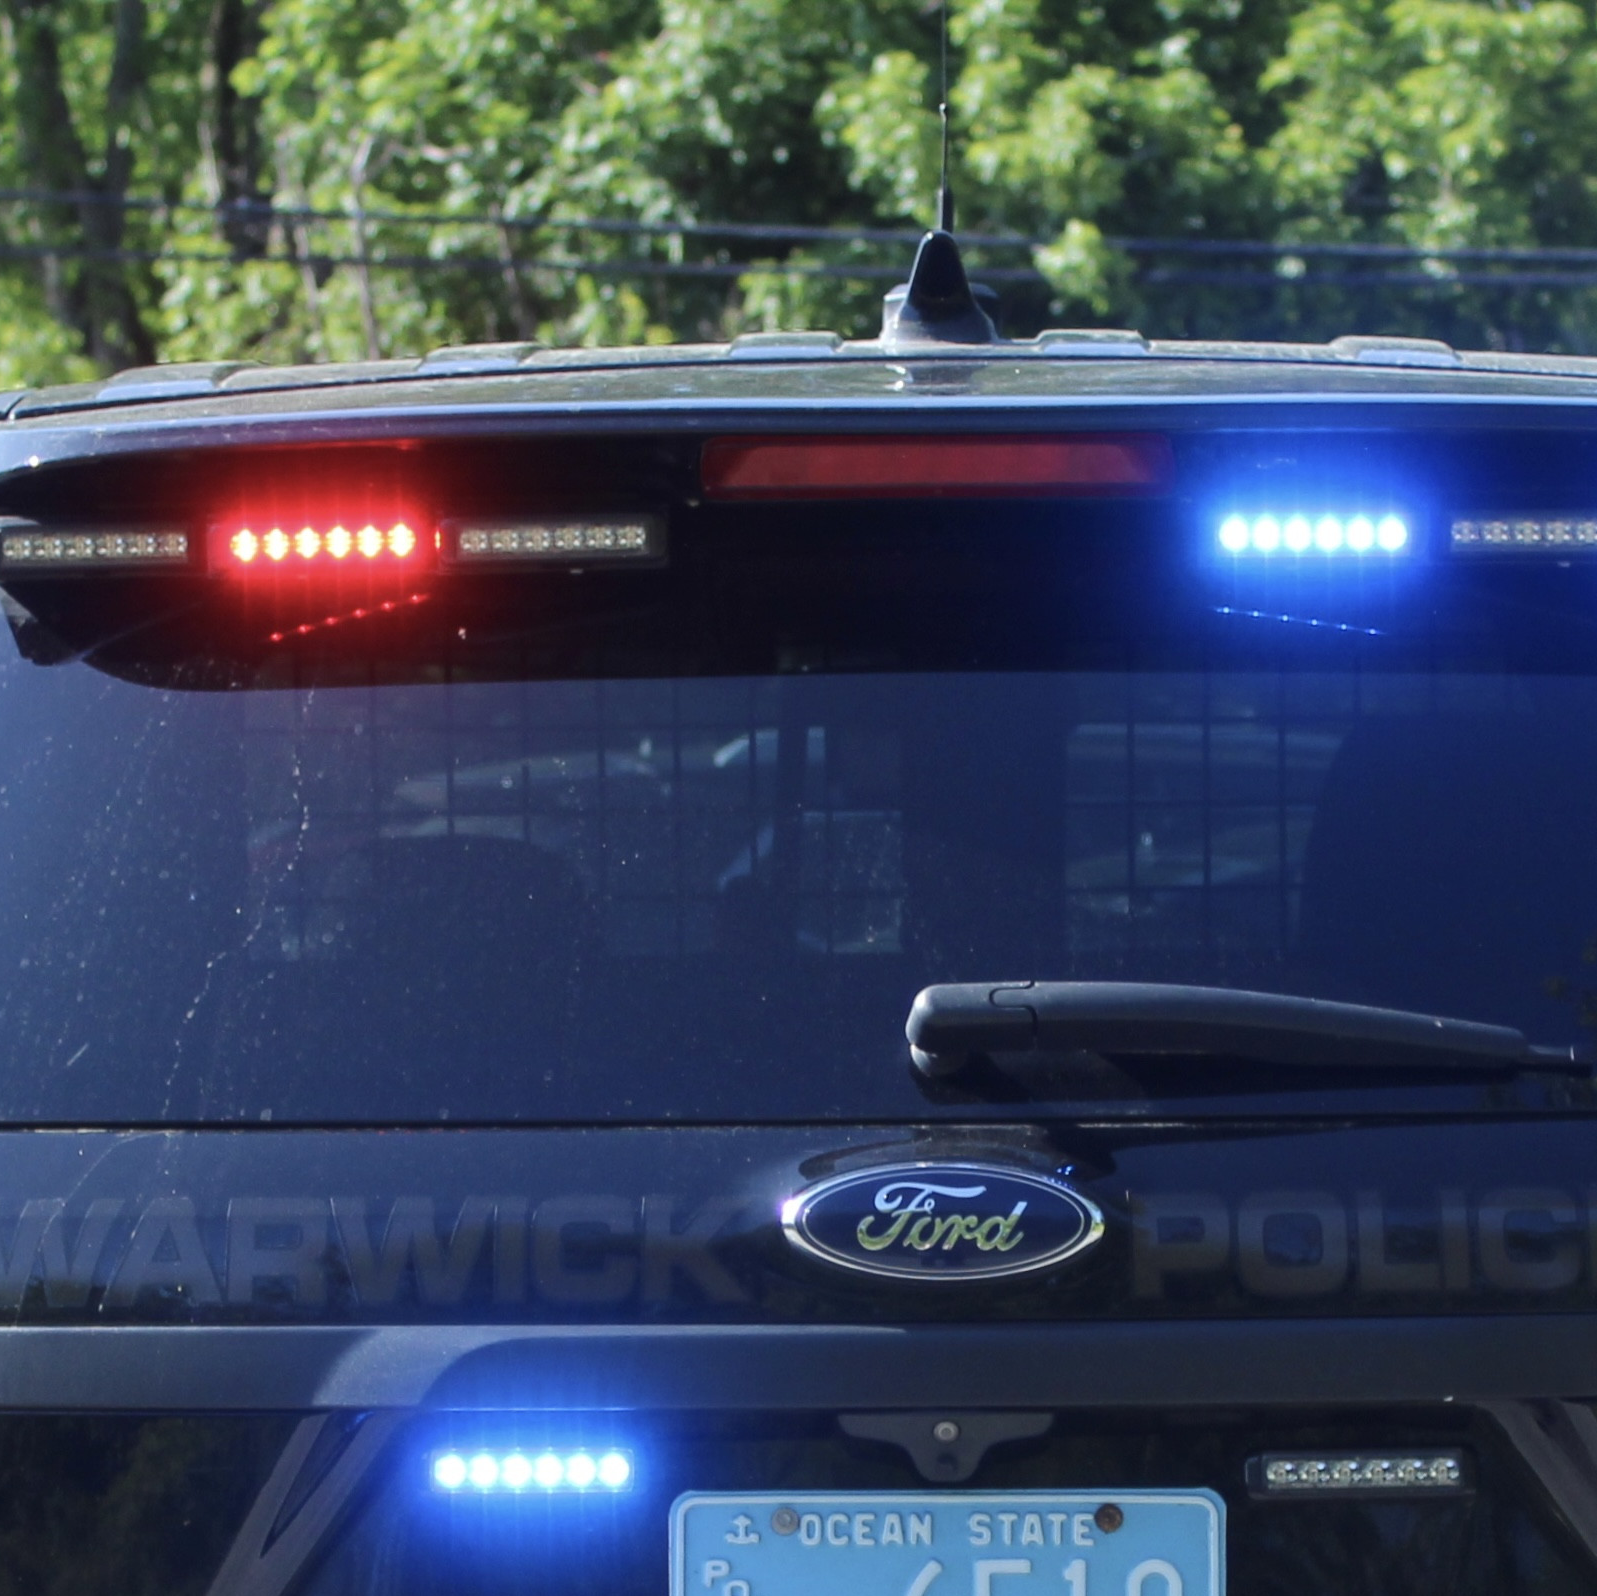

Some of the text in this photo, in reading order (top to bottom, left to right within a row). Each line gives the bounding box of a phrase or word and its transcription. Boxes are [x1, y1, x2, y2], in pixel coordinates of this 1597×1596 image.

[857, 1182, 1028, 1251] Ford
[799, 1513, 1095, 1546] OCEAN STATE
